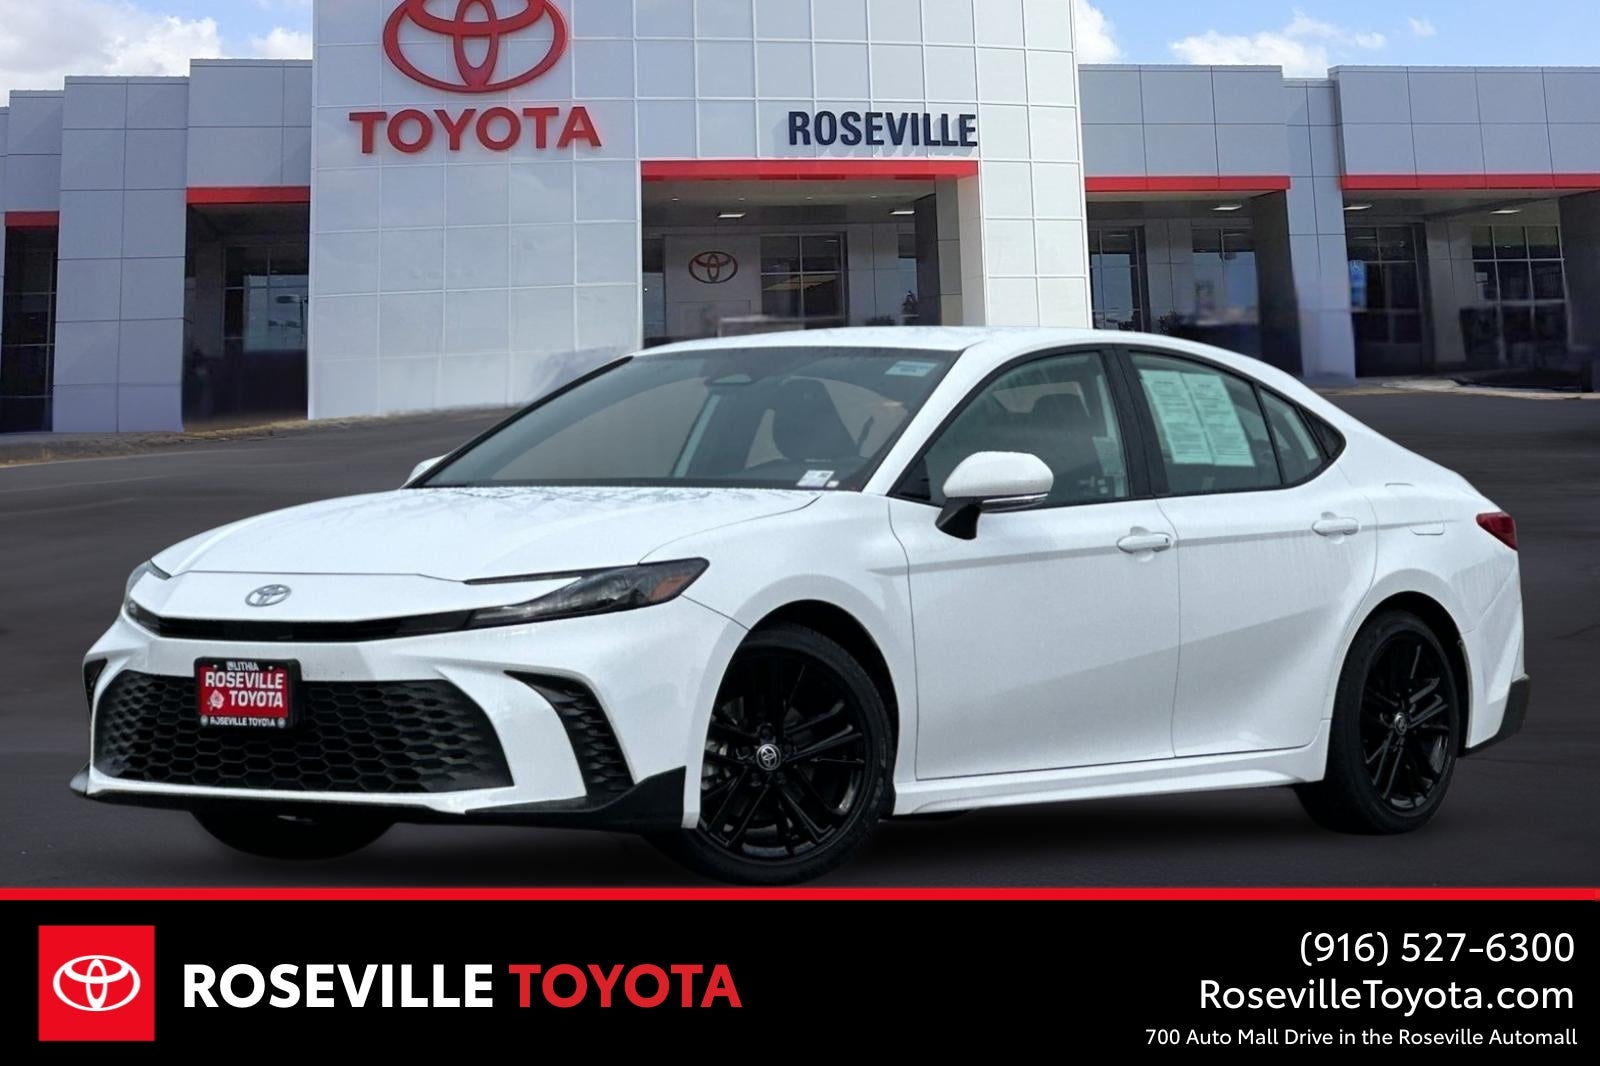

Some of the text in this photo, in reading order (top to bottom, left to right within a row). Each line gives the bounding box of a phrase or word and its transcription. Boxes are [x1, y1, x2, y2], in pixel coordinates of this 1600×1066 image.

[350, 106, 602, 154] TOYOTA
[788, 111, 979, 147] ROSEVILLE
[234, 662, 259, 671] LITHIA
[205, 671, 284, 689] ROSEVILLE
[229, 690, 284, 707] TOYOTA
[249, 717, 275, 727] TOYOTA
